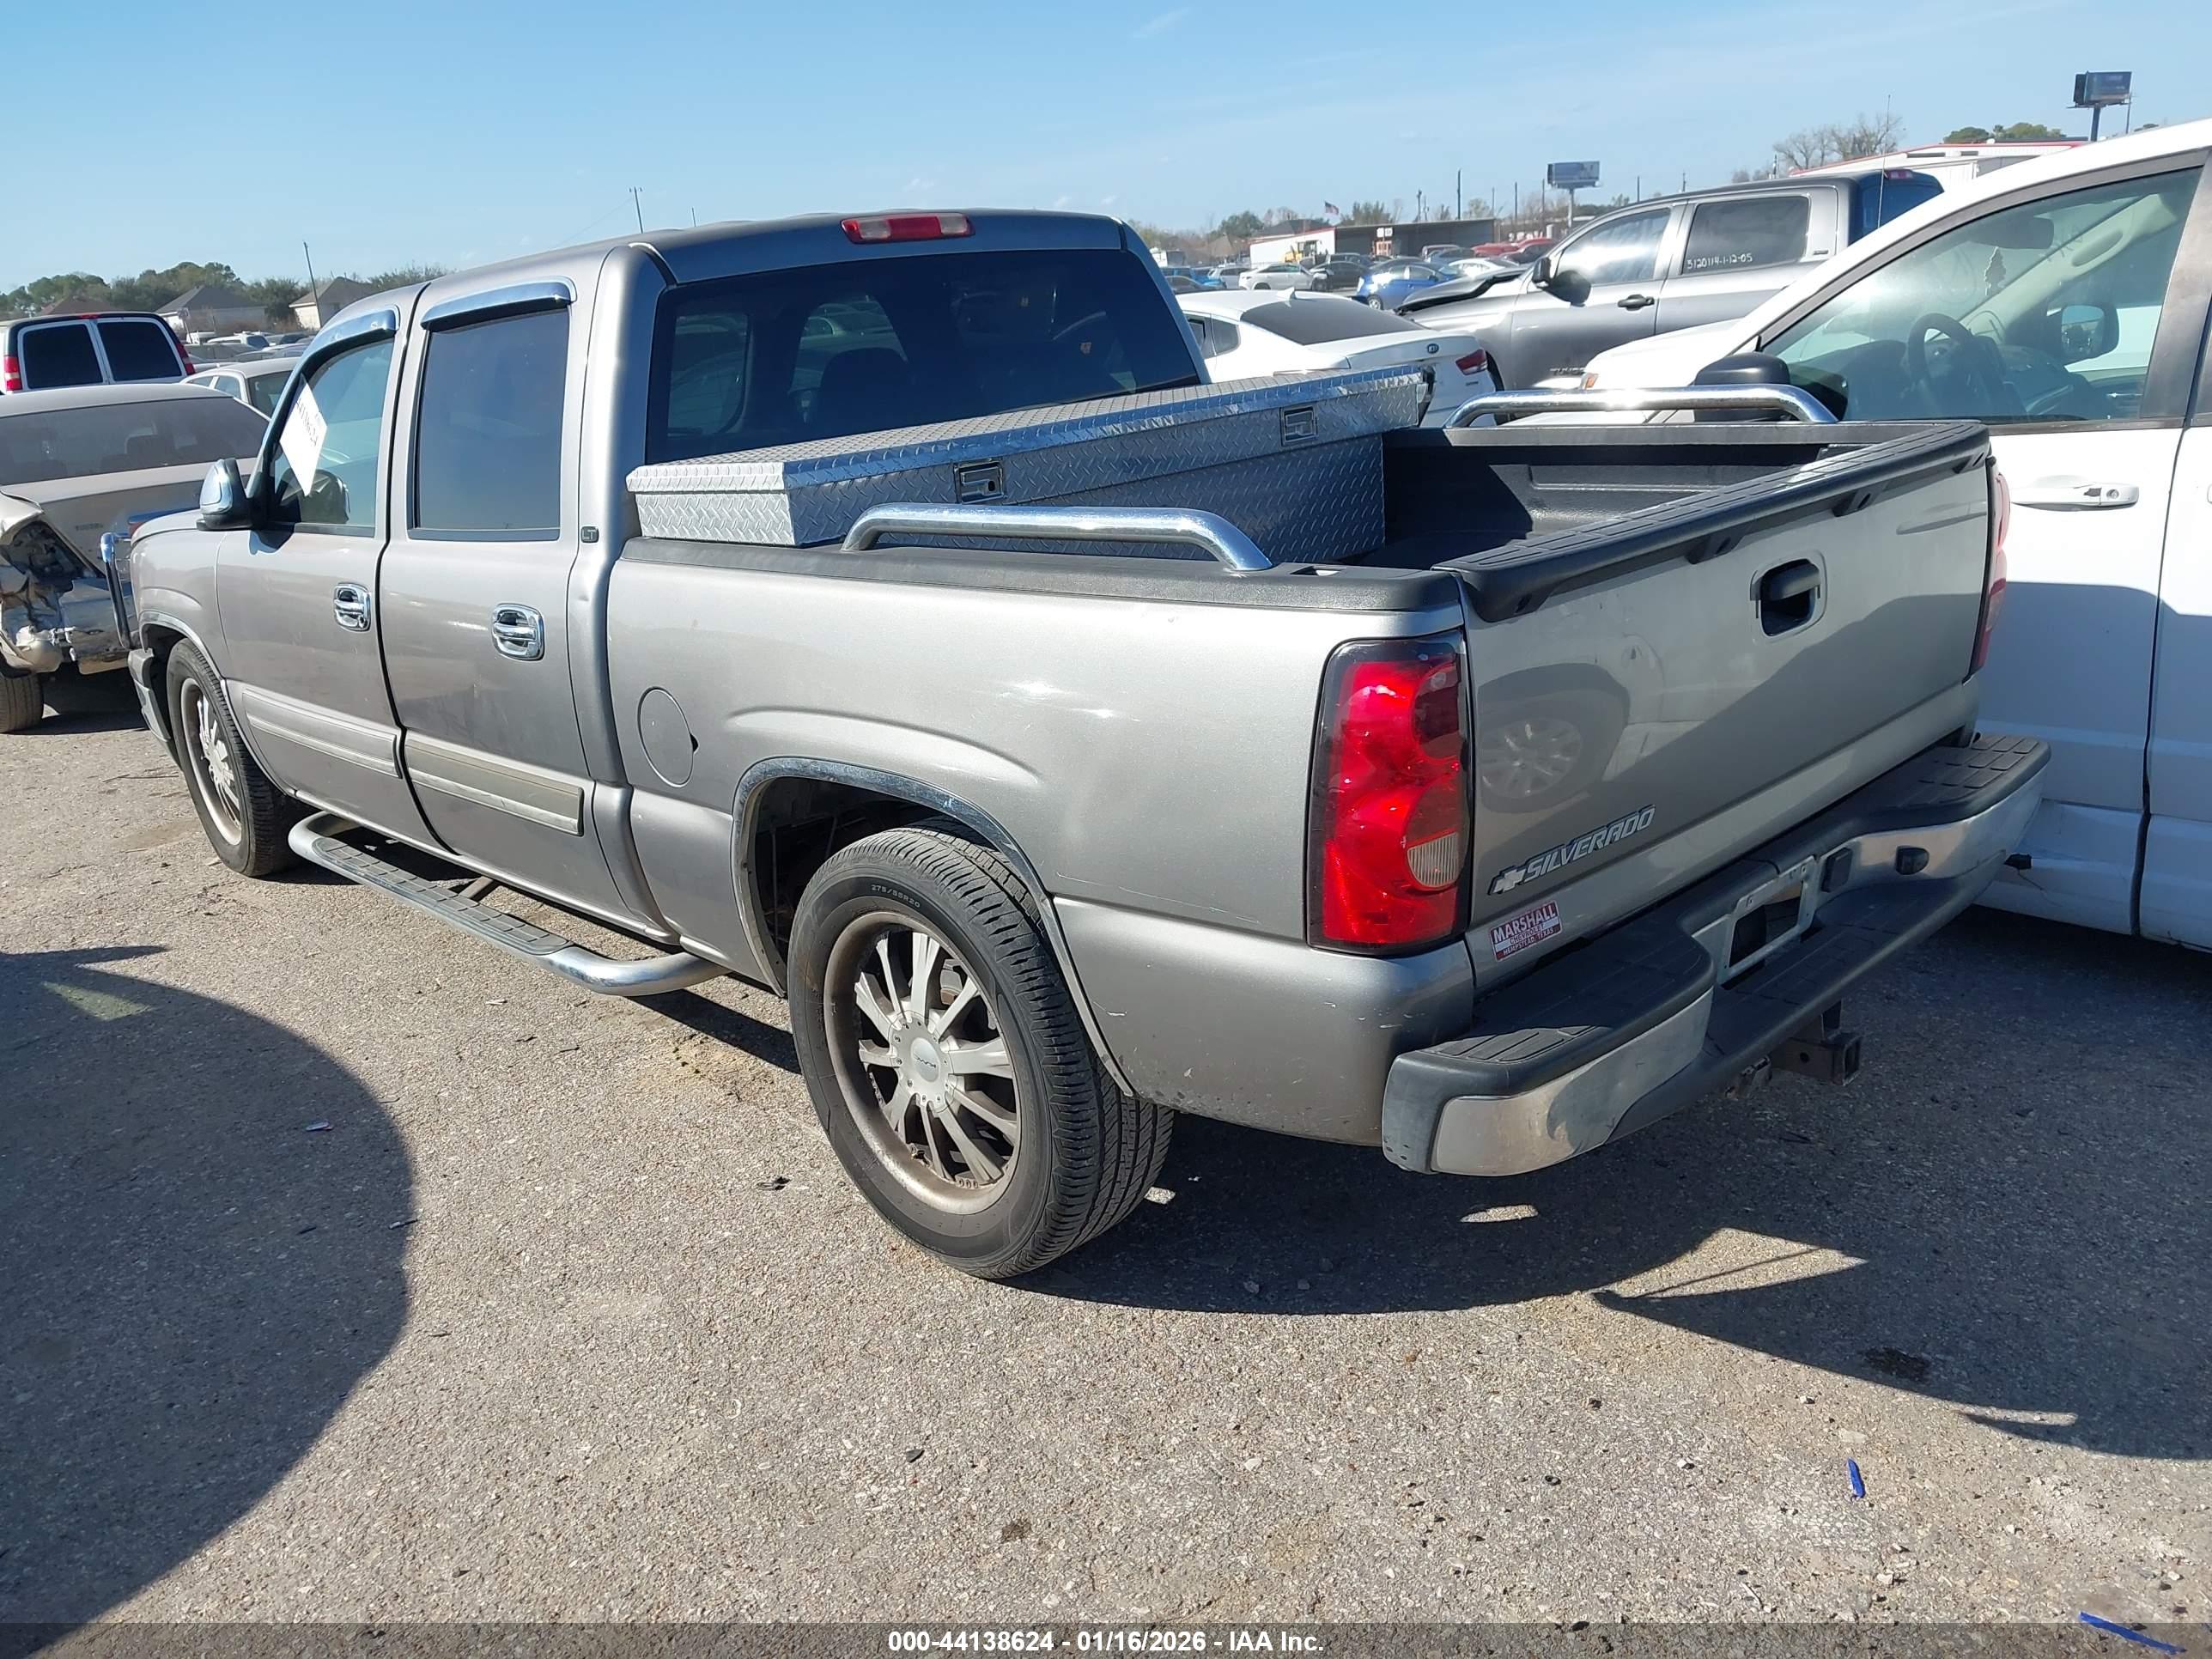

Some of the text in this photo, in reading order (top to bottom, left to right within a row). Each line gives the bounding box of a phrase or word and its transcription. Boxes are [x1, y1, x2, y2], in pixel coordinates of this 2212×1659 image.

[581, 529, 597, 540] LT
[1524, 807, 1656, 883] SILVERADO
[1494, 904, 1556, 944] MARSHALL
[1537, 927, 1554, 941] TEXAS
